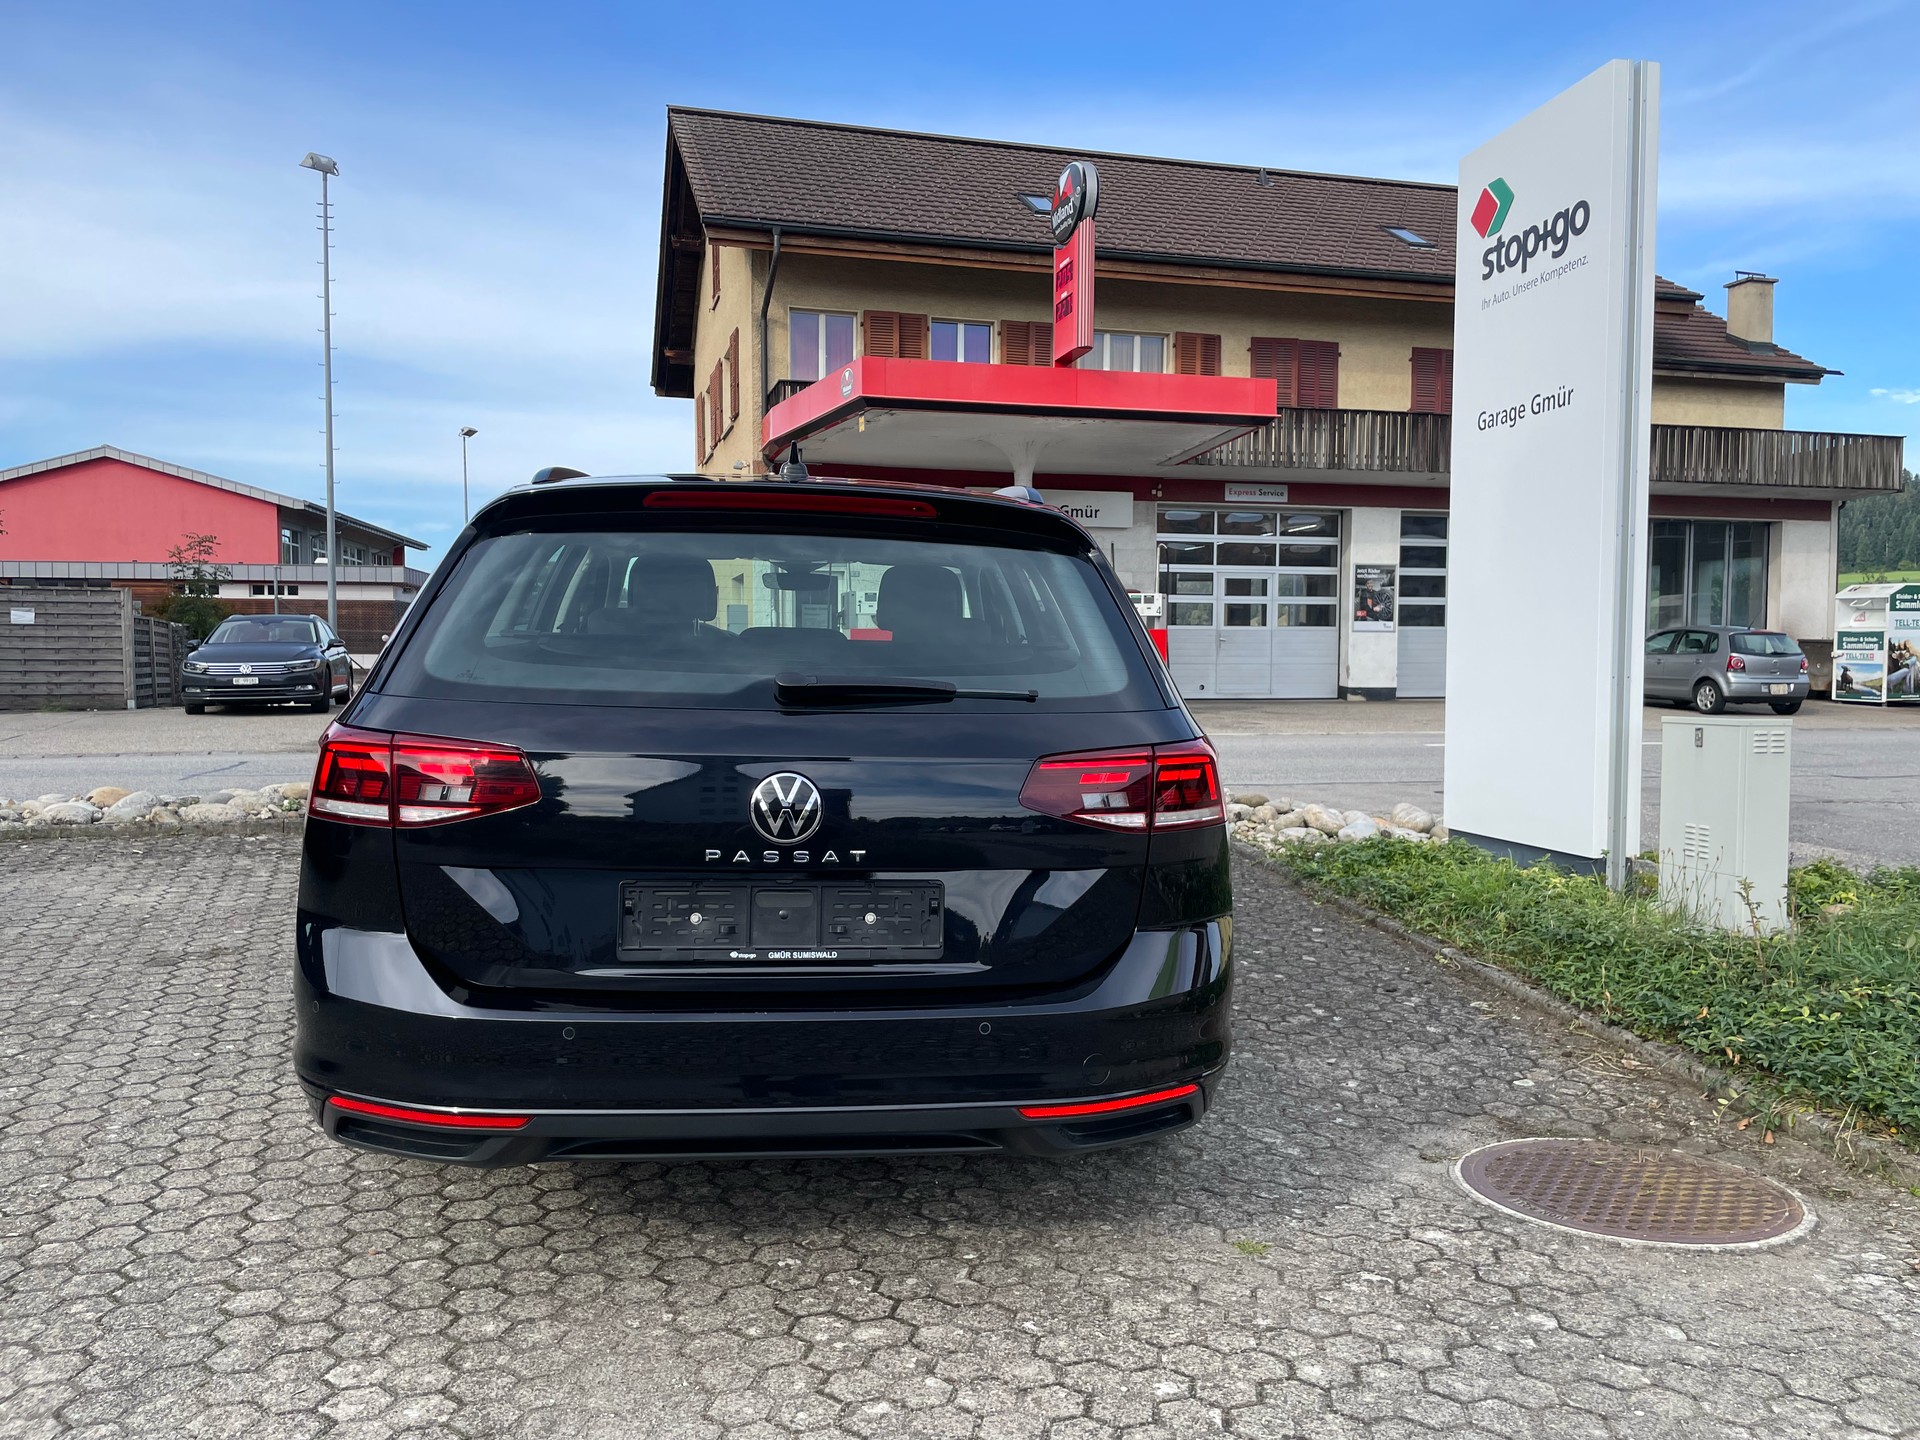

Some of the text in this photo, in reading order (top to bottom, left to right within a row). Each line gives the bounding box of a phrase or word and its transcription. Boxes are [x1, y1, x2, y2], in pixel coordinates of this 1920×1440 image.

[1482, 200, 1590, 280] stop+go
[1481, 255, 1589, 311] Ihr Auto. Unsere Kompetenz.
[1477, 386, 1574, 431] Garage Gmür
[1228, 487, 1285, 497] Express Service
[1156, 606, 1161, 615] 4
[1842, 642, 1879, 651] Sammlung
[704, 849, 867, 863] PASSAT
[768, 950, 791, 959] GMÜR
[792, 951, 838, 959] SUMISWALD
